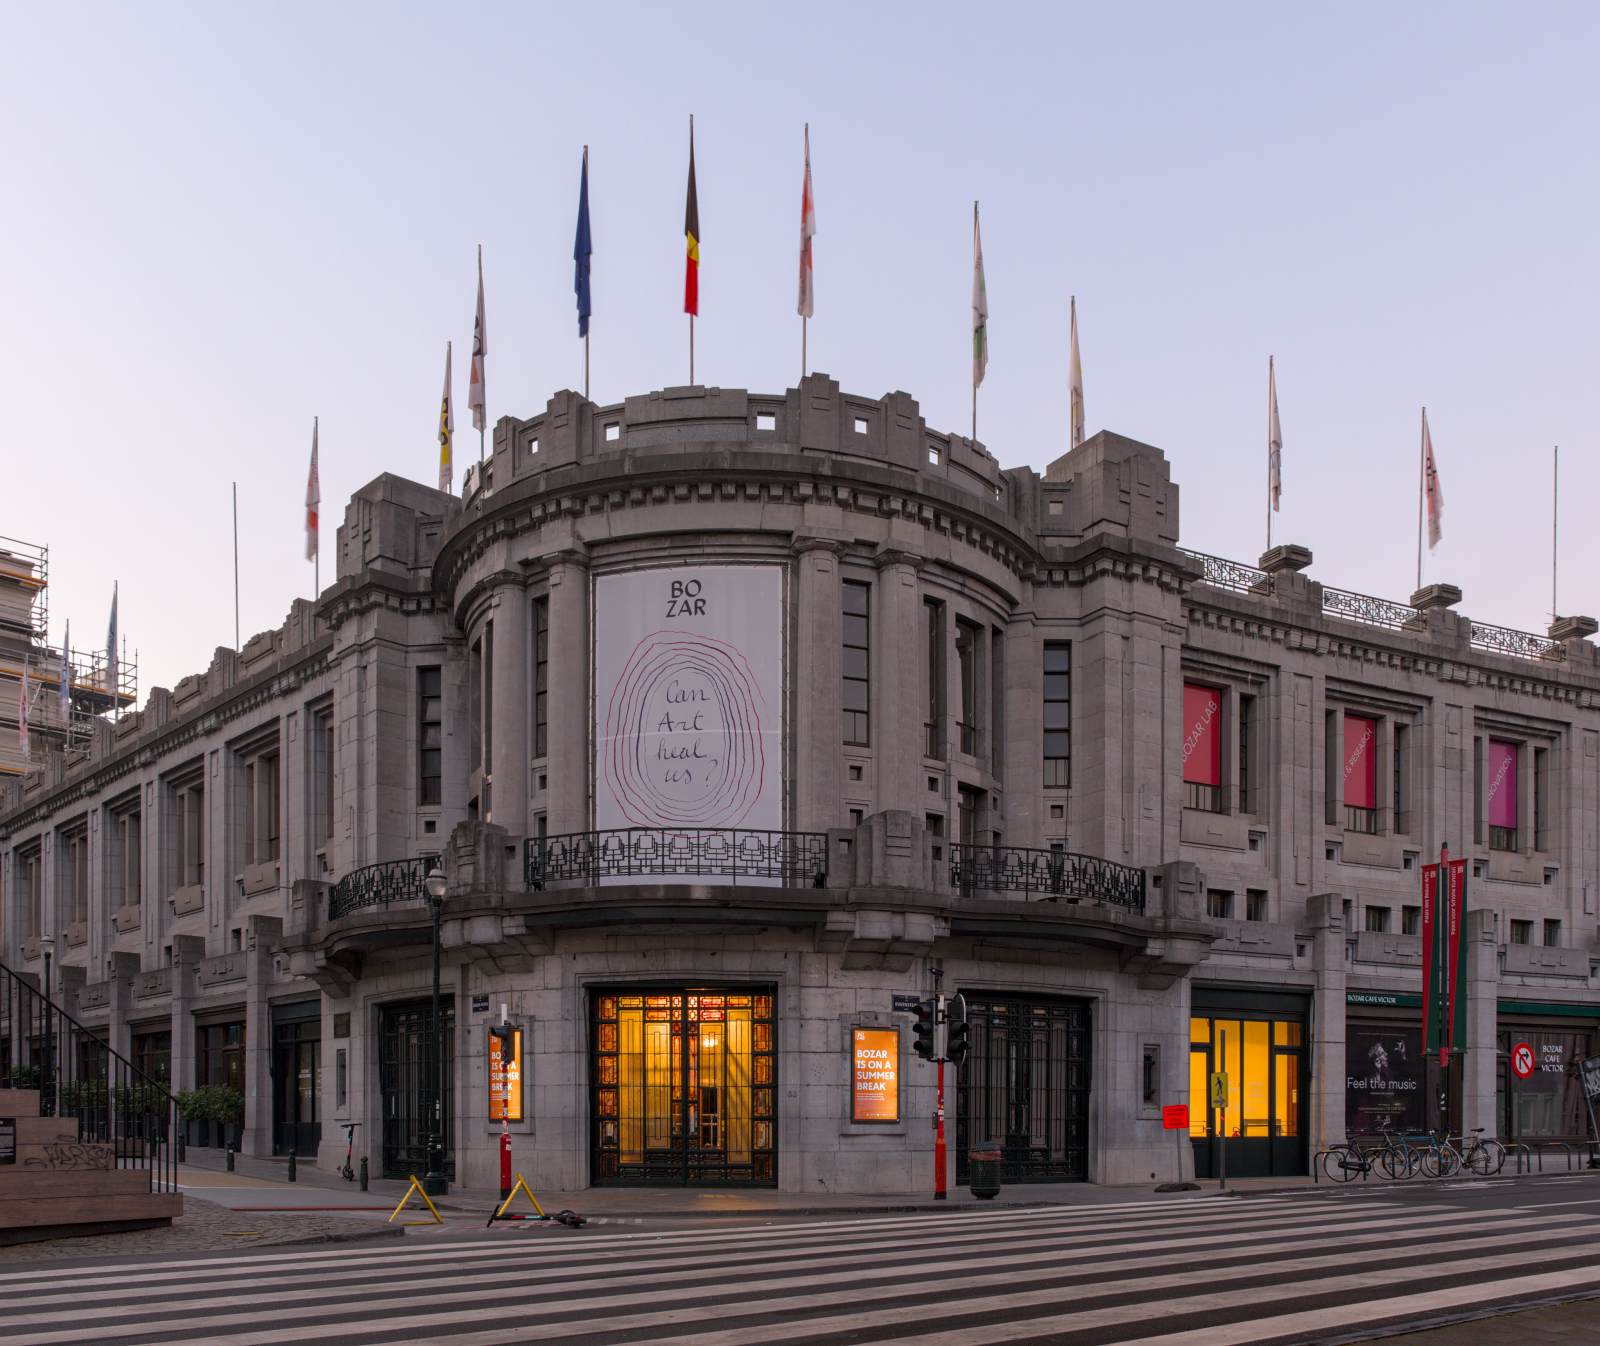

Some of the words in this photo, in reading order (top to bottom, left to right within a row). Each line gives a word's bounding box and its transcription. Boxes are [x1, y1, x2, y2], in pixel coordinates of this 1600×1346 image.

[671, 579, 702, 598] BO
[666, 599, 706, 618] ZAR
[666, 680, 711, 704] Can
[1201, 700, 1217, 724] LAB
[658, 712, 704, 732] Art
[658, 740, 707, 761] heal
[1488, 755, 1513, 800] NOVATION
[857, 1049, 888, 1058] BOZAR
[1542, 1045, 1563, 1053] BOZAR
[857, 1060, 866, 1069] IS
[868, 1060, 882, 1069] ON
[885, 1061, 892, 1069] A
[1545, 1055, 1560, 1063] CAFE
[857, 1071, 895, 1080] SUMMER
[491, 1082, 513, 1091] BREK
[857, 1082, 886, 1091] BREAK
[1347, 1077, 1368, 1089] Feel
[1370, 1078, 1386, 1089] the
[1388, 1078, 1417, 1090] music
